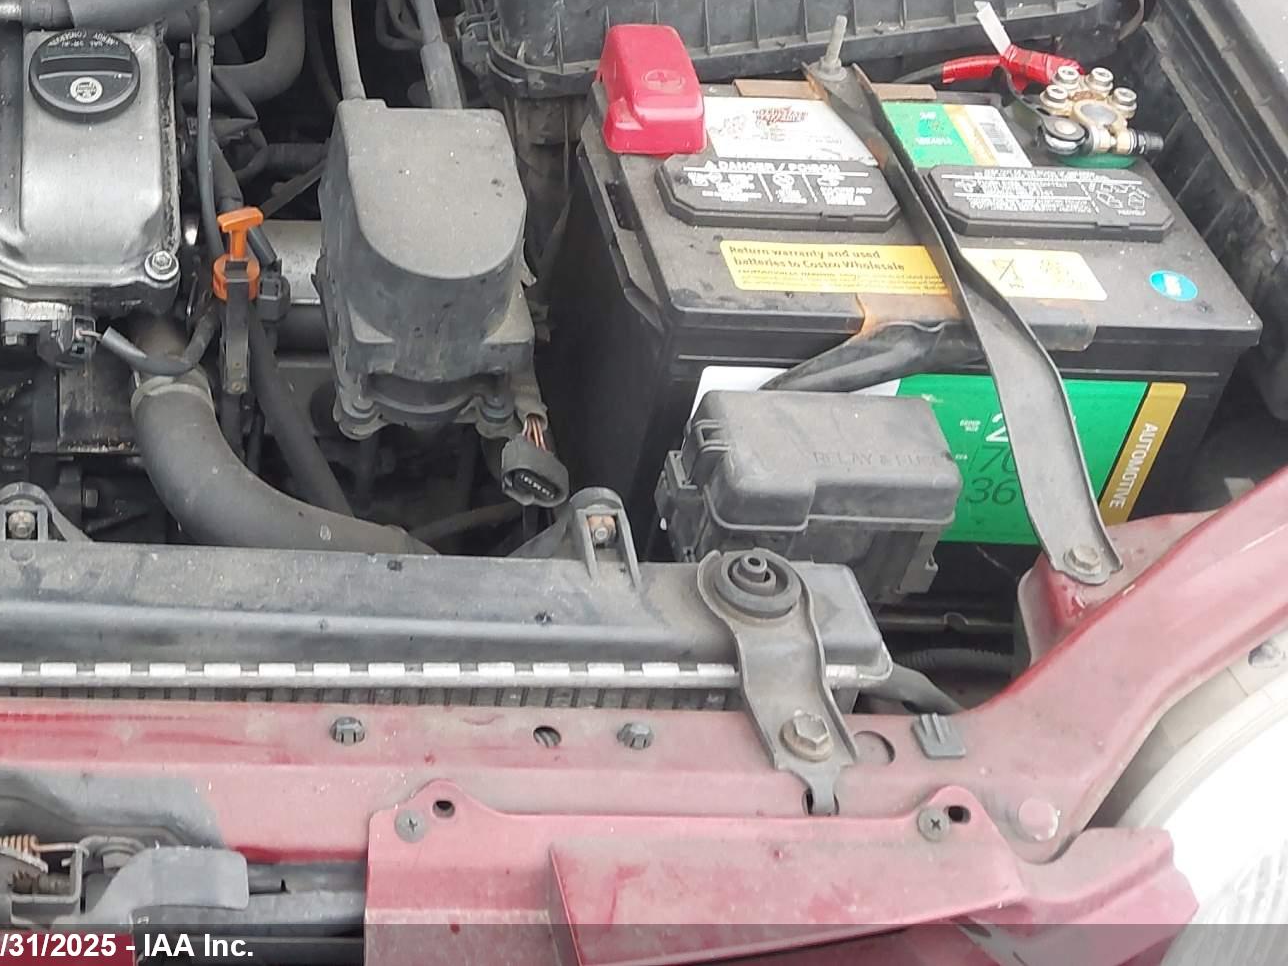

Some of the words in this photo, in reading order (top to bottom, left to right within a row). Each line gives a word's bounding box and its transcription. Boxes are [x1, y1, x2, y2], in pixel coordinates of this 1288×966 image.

[719, 160, 776, 172] DANGER
[789, 162, 841, 174] POISON
[729, 245, 770, 255] Return
[772, 248, 824, 260] warranty
[827, 249, 850, 258] and
[852, 250, 881, 259] used
[733, 255, 786, 267] batteries
[787, 259, 800, 268] to
[842, 260, 905, 271] Wholesale
[1109, 422, 1159, 509] AUTOMOTIVE
